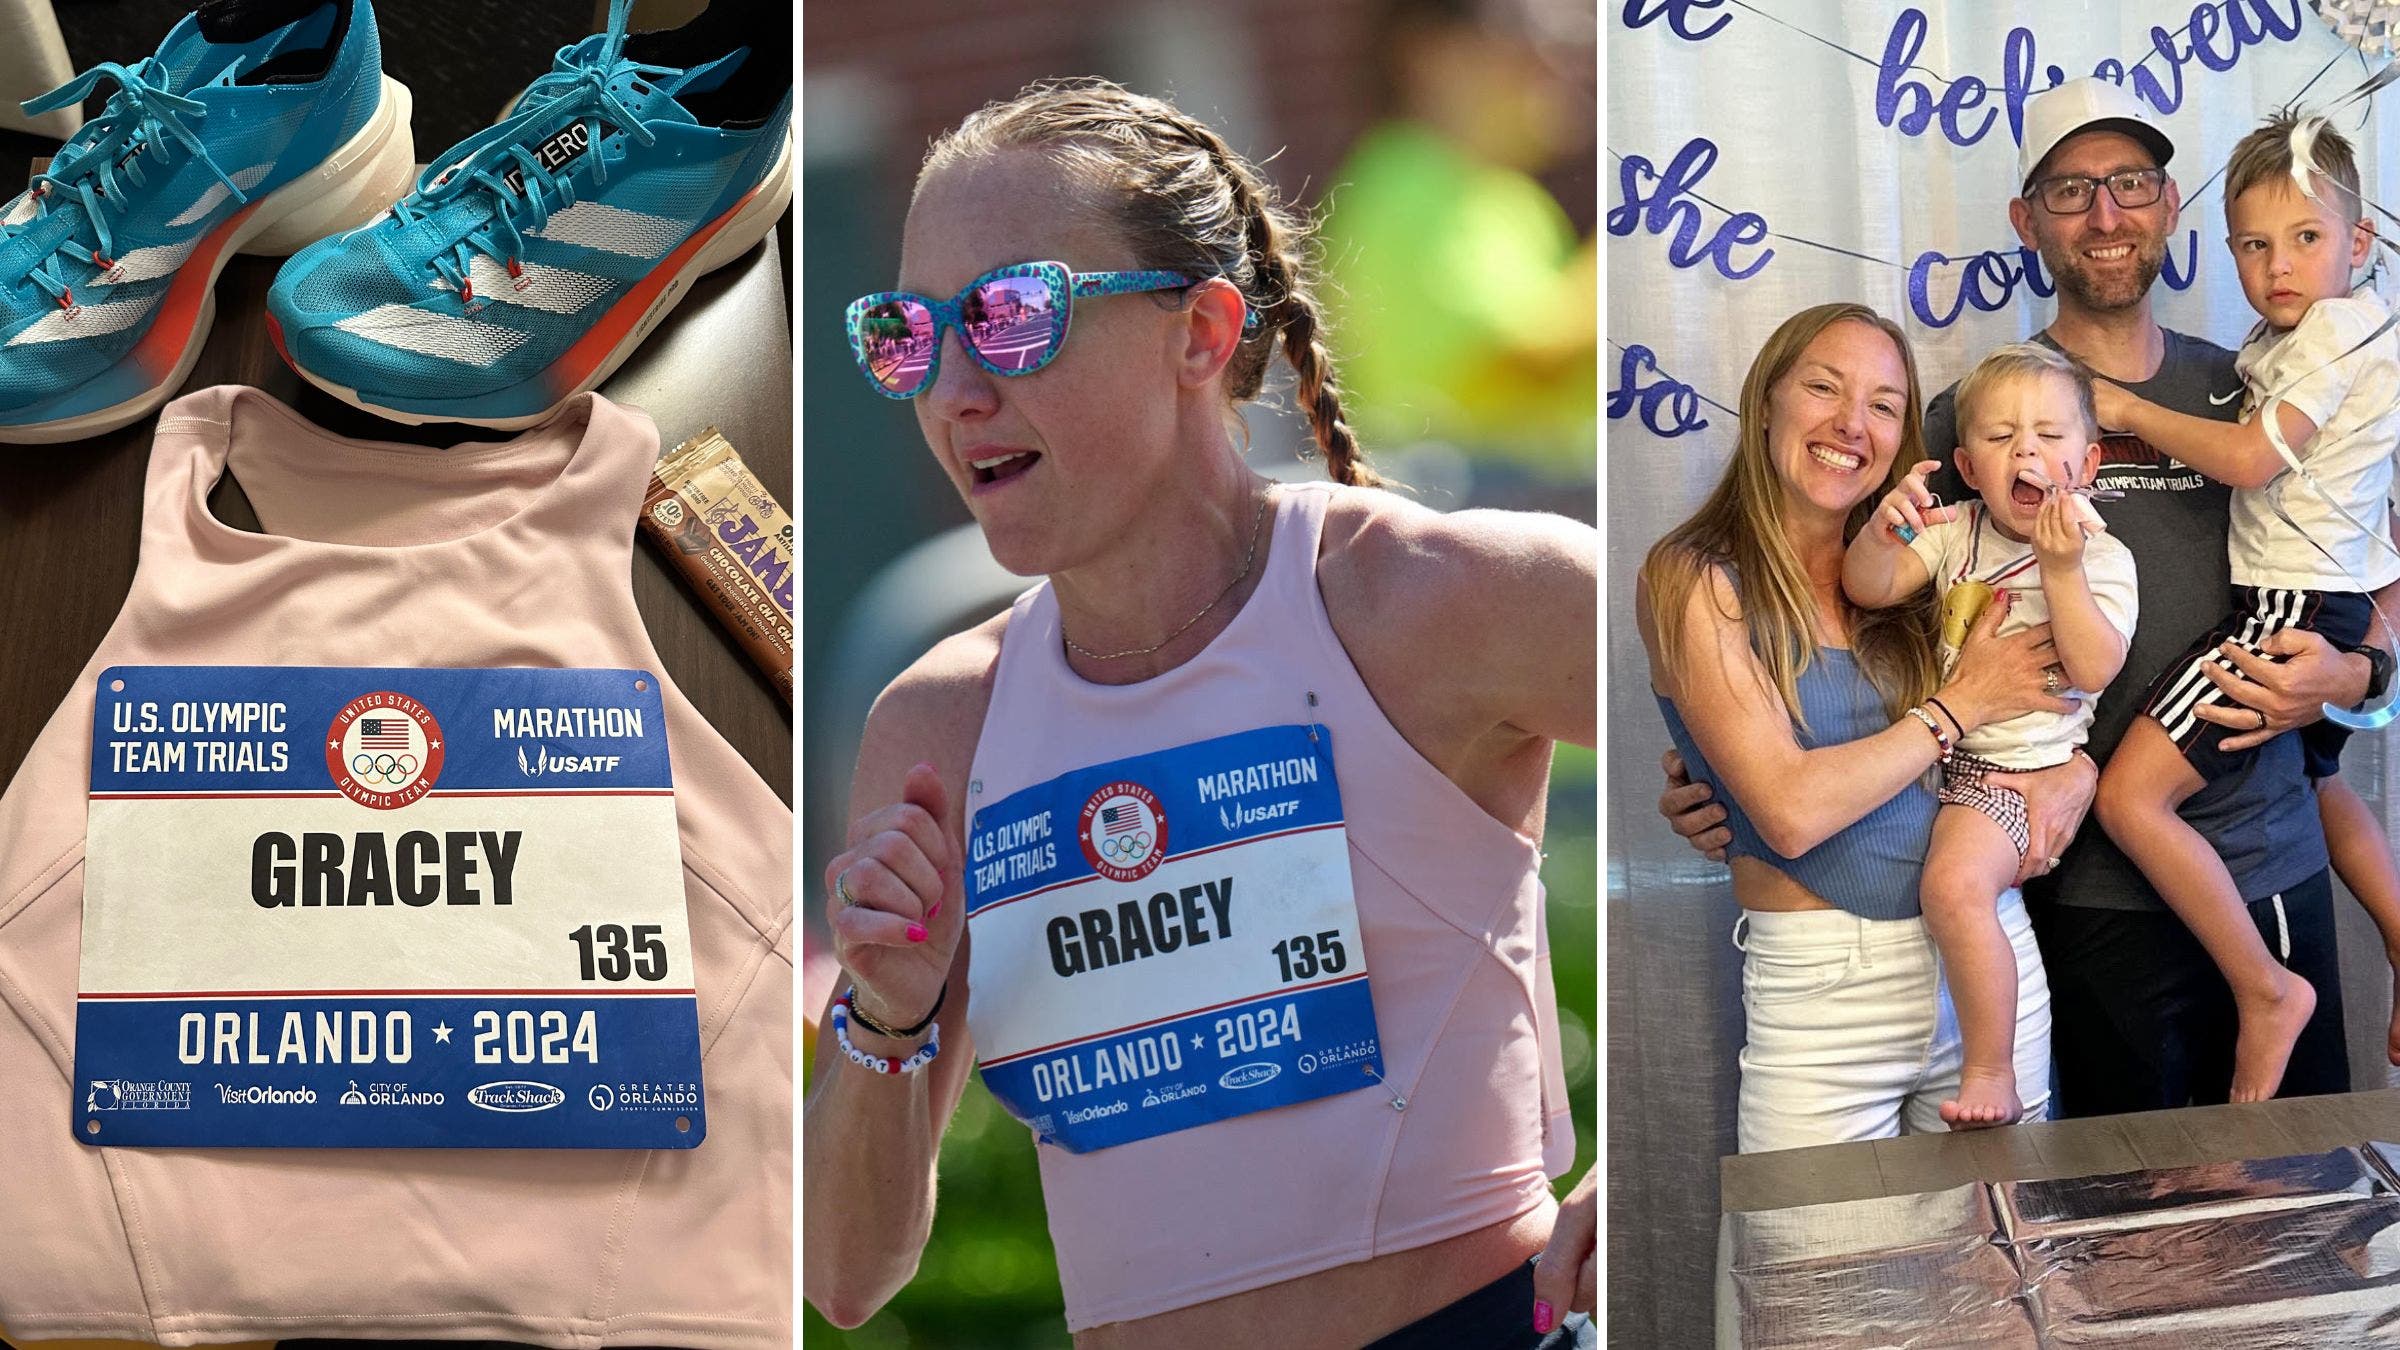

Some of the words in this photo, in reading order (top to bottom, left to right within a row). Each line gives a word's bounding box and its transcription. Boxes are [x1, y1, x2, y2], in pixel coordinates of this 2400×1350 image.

[1607, 137, 1775, 280] she
[1607, 344, 1709, 438] so
[2096, 476, 2140, 491] OLYMPIC
[2139, 476, 2166, 490] TEAM
[2166, 474, 2204, 491] TRIALS
[718, 514, 793, 619] JAMB
[708, 545, 762, 605] CHOCOLATE
[756, 601, 781, 627] CHA
[722, 581, 751, 613] Chocolate
[752, 615, 771, 636] Whole
[767, 634, 788, 655] Grains
[113, 702, 164, 733] U.S.
[171, 702, 287, 733] OLYMPIC
[340, 695, 381, 724] UNITED
[388, 695, 430, 724] STATES
[493, 708, 644, 738] MARATHON
[110, 741, 186, 773] TEAM
[193, 741, 289, 773] TRIALS
[549, 756, 622, 773] USATF
[341, 777, 391, 807] OLYMPIC
[399, 778, 430, 804] TEAM
[1197, 756, 1318, 804] MARATHON
[1084, 787, 1114, 818] UNITED
[1117, 783, 1154, 805] STATES
[1243, 800, 1300, 825] USATF
[973, 832, 996, 862] U.S.
[998, 810, 1052, 853] OLYMPIC
[251, 830, 523, 908] GRACEY
[974, 864, 1006, 895] TEAM
[1008, 842, 1058, 882] TRIALS
[1096, 860, 1138, 880] OLYMPIC
[1142, 848, 1164, 874] TEAM
[1046, 876, 1233, 978] GRACEY
[568, 924, 668, 982] 135
[1272, 929, 1347, 983] 135
[178, 1011, 412, 1065] ORLANDO
[473, 1010, 599, 1064] 2024
[1032, 1031, 1183, 1102] ORLANDO
[1215, 1003, 1302, 1058] 2024
[1319, 1039, 1375, 1056] GREATER
[1320, 1045, 1376, 1065] ORLANDO
[122, 1091, 191, 1101] GOVERNMENT
[370, 1083, 391, 1092] CITY
[394, 1083, 408, 1092] OF
[370, 1093, 445, 1105] ORLANDO
[474, 1088, 514, 1105] Track
[516, 1088, 561, 1105] Shack
[619, 1092, 697, 1104] ORLANDO
[1160, 1084, 1174, 1094] CITY
[1160, 1084, 1207, 1103] ORLANDO
[122, 1101, 190, 1109] FLORIDA
